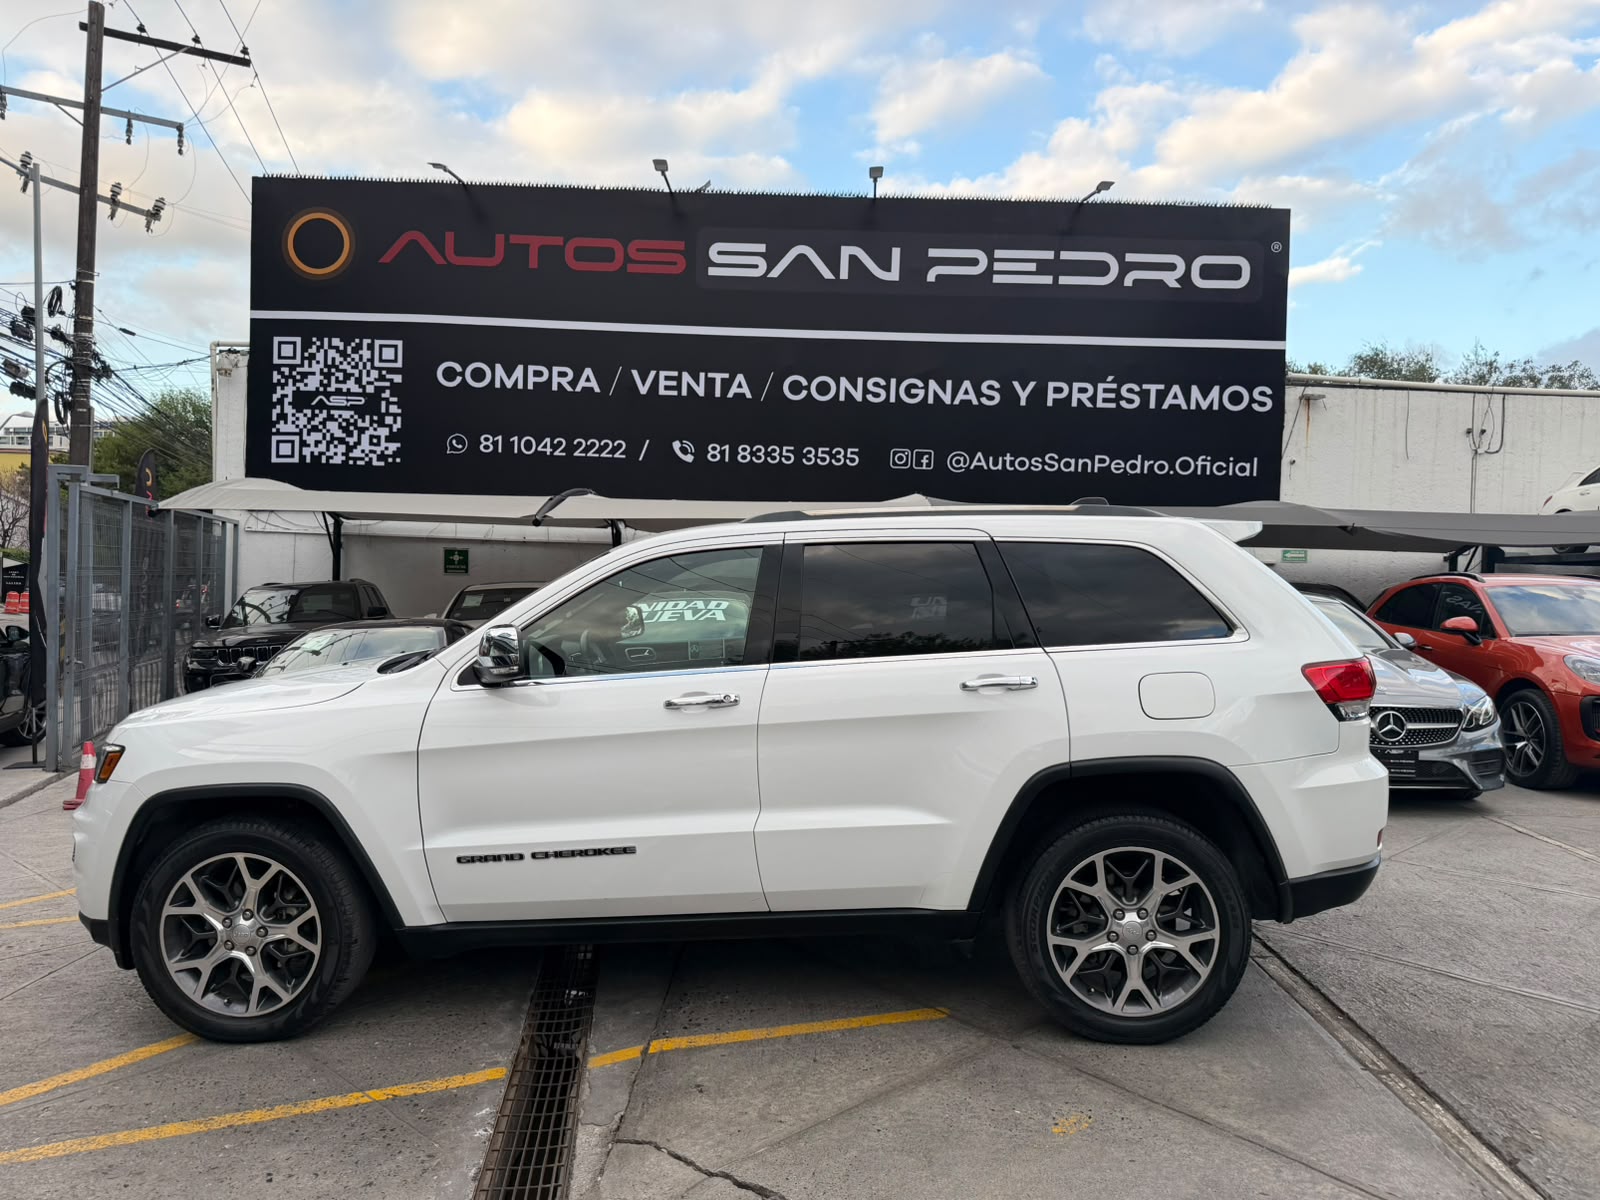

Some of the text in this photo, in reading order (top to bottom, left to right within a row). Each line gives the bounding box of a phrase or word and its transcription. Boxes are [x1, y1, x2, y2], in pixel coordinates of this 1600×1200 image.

[379, 229, 687, 275] AUTOS
[707, 241, 901, 282] SAN
[926, 247, 1251, 290] PEDRO
[436, 361, 601, 393] COMPRA
[630, 369, 753, 399] VENTA
[782, 374, 1001, 406] CONSIGNAS
[1011, 380, 1037, 406] Y
[1046, 375, 1273, 412] PRÉSTAMOS
[479, 434, 503, 453] 81
[509, 435, 567, 456] 1042
[573, 438, 627, 459] 2222
[706, 443, 860, 467] 81 8335 3535
[946, 451, 1258, 478] @AutosSanPedro.Oficial
[642, 609, 726, 623] UEVA
[456, 846, 637, 865] GRAND CHEROKEE
